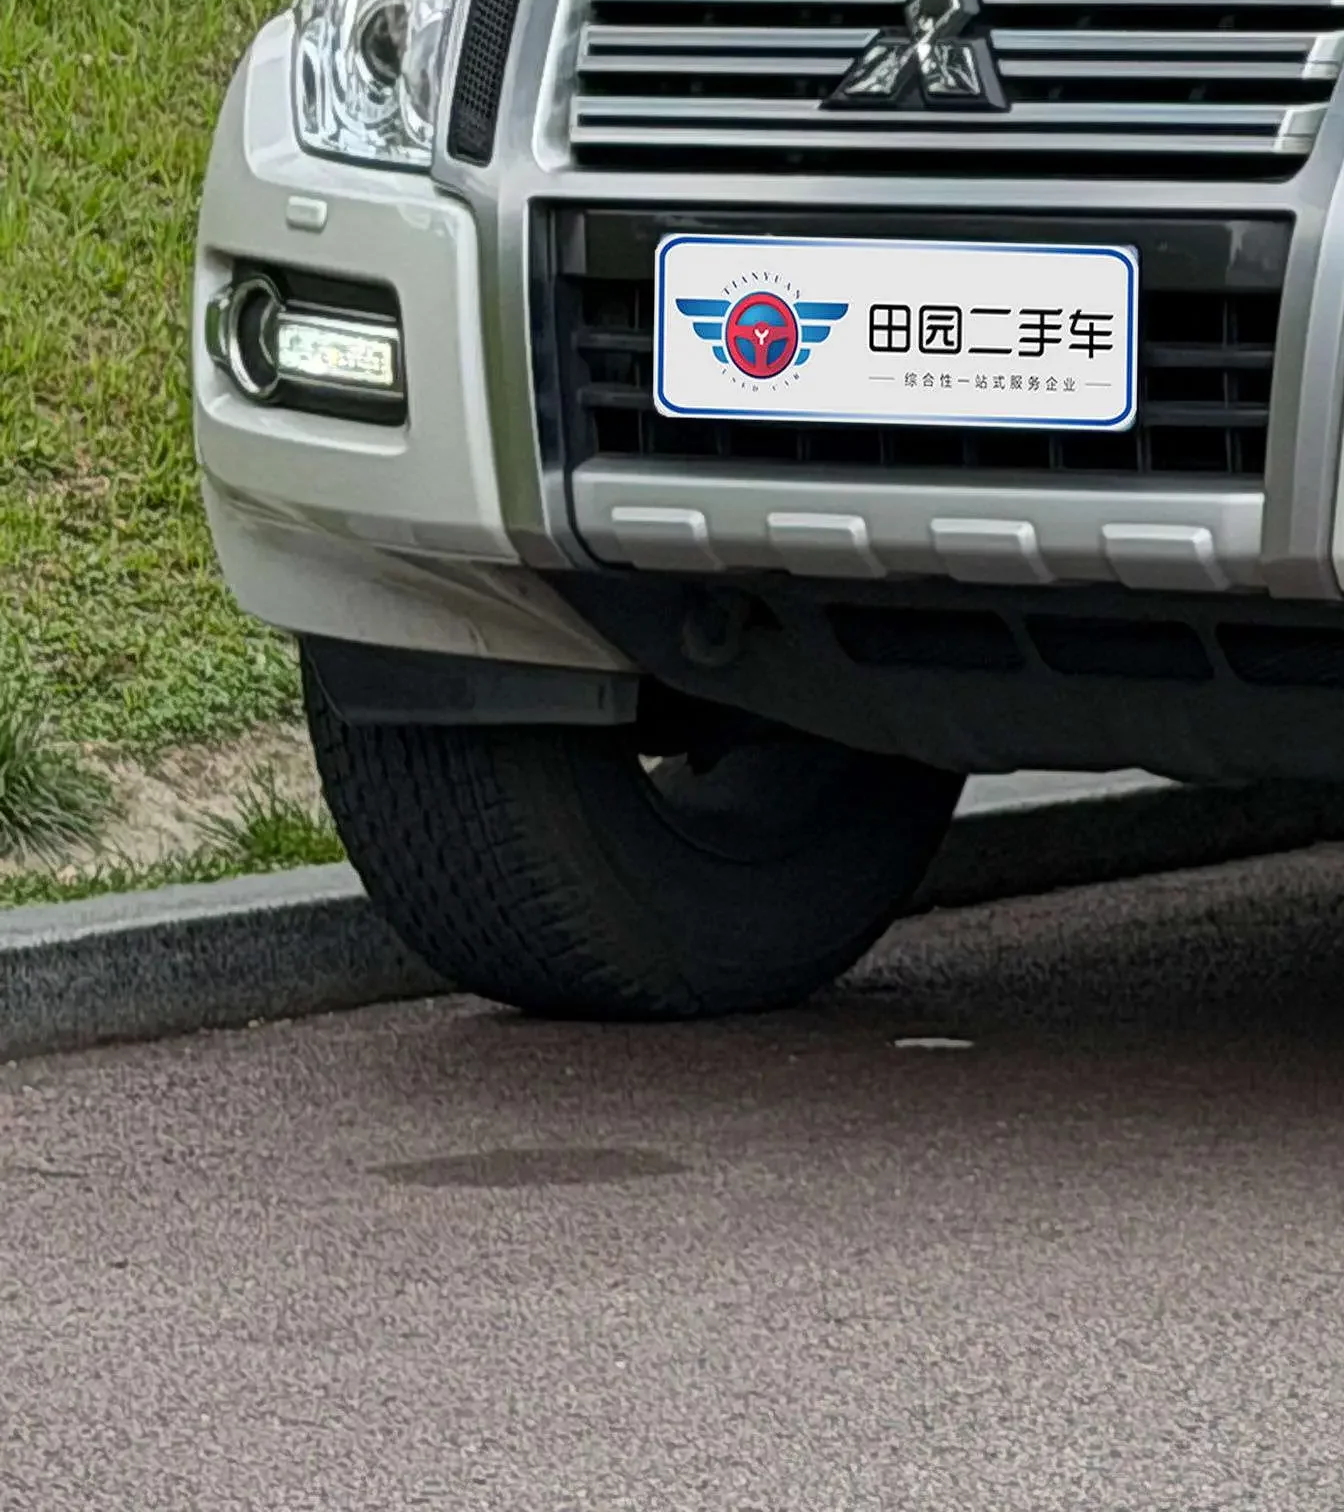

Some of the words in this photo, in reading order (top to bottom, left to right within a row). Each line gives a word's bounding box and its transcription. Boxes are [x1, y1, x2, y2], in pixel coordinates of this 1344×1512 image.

[869, 304, 1114, 359] 田园二手车
[904, 371, 1076, 392] 综合性一站式服务企业
